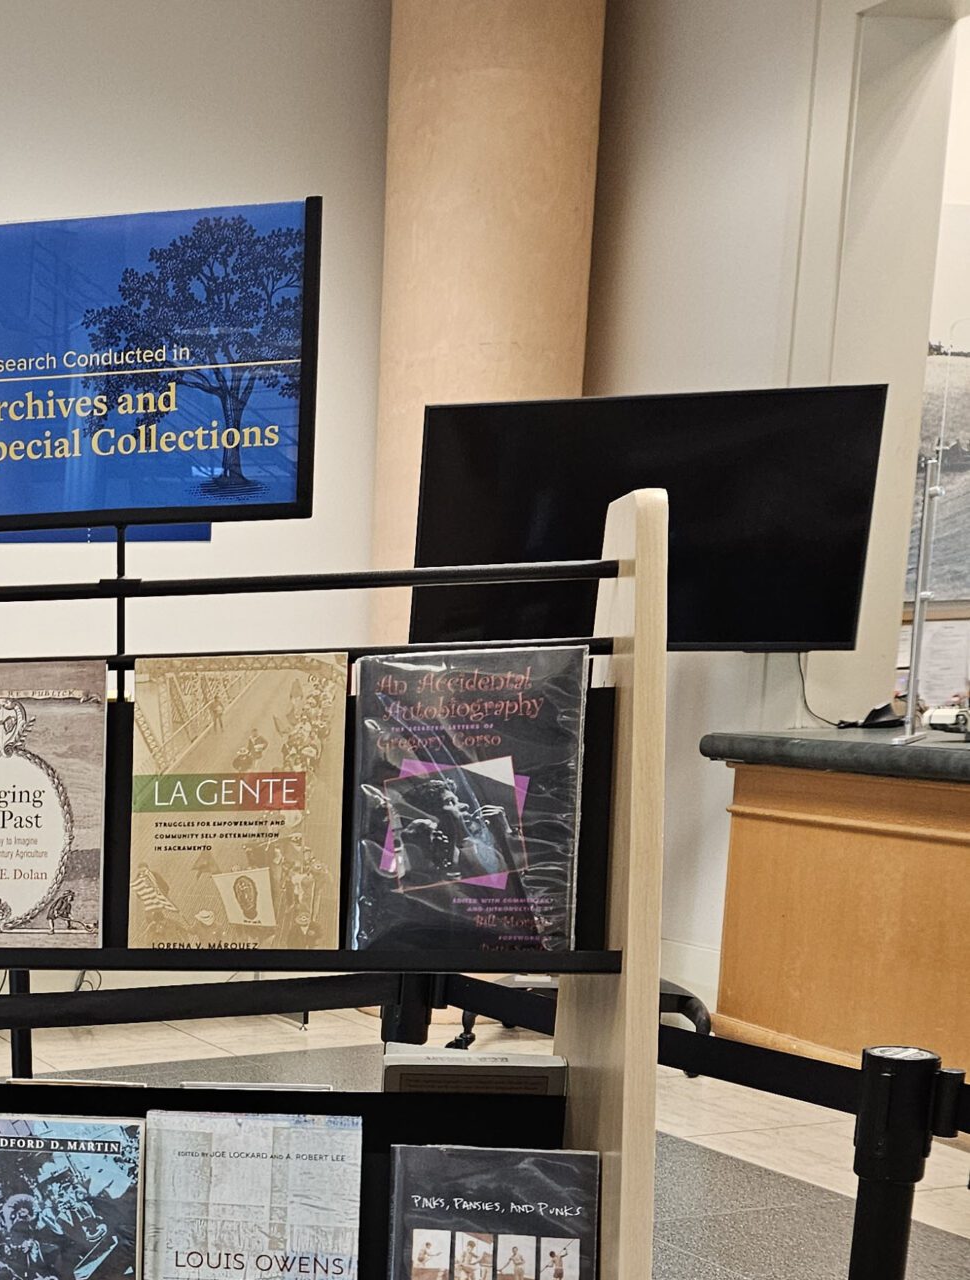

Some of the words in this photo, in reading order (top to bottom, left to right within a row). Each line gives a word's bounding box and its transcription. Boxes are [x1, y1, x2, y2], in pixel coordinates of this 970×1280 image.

[63, 346, 166, 368] Conducted
[172, 344, 189, 361] in
[117, 382, 178, 414] and
[91, 420, 279, 456] Collections
[377, 675, 408, 696] An
[416, 666, 533, 693] Accidental
[383, 692, 545, 722] Autobiography
[376, 734, 445, 752] Gregory
[451, 732, 502, 747] Corso
[154, 780, 188, 806] LA
[195, 778, 298, 806] GENTE
[0, 810, 43, 829] Past
[6, 836, 13, 846] to
[14, 836, 38, 848] Imagine
[15, 848, 48, 859] Agriculture
[0, 868, 10, 880] E.
[13, 868, 48, 880] Dolan
[151, 942, 192, 950] LORENA
[209, 940, 259, 950] MÁRQUEZ
[50, 1139, 65, 1150] D.
[67, 1140, 120, 1153] MARTIN
[209, 1151, 226, 1159] JOE
[228, 1151, 268, 1160] LOCKARD
[295, 1154, 329, 1162] ROBERT
[411, 1194, 450, 1211] PINKS,
[453, 1197, 506, 1213] PANSIES,
[510, 1202, 535, 1213] AND
[537, 1202, 583, 1217] PUNKS
[175, 1250, 245, 1270] LOUIS
[255, 1255, 345, 1275] OWENS
